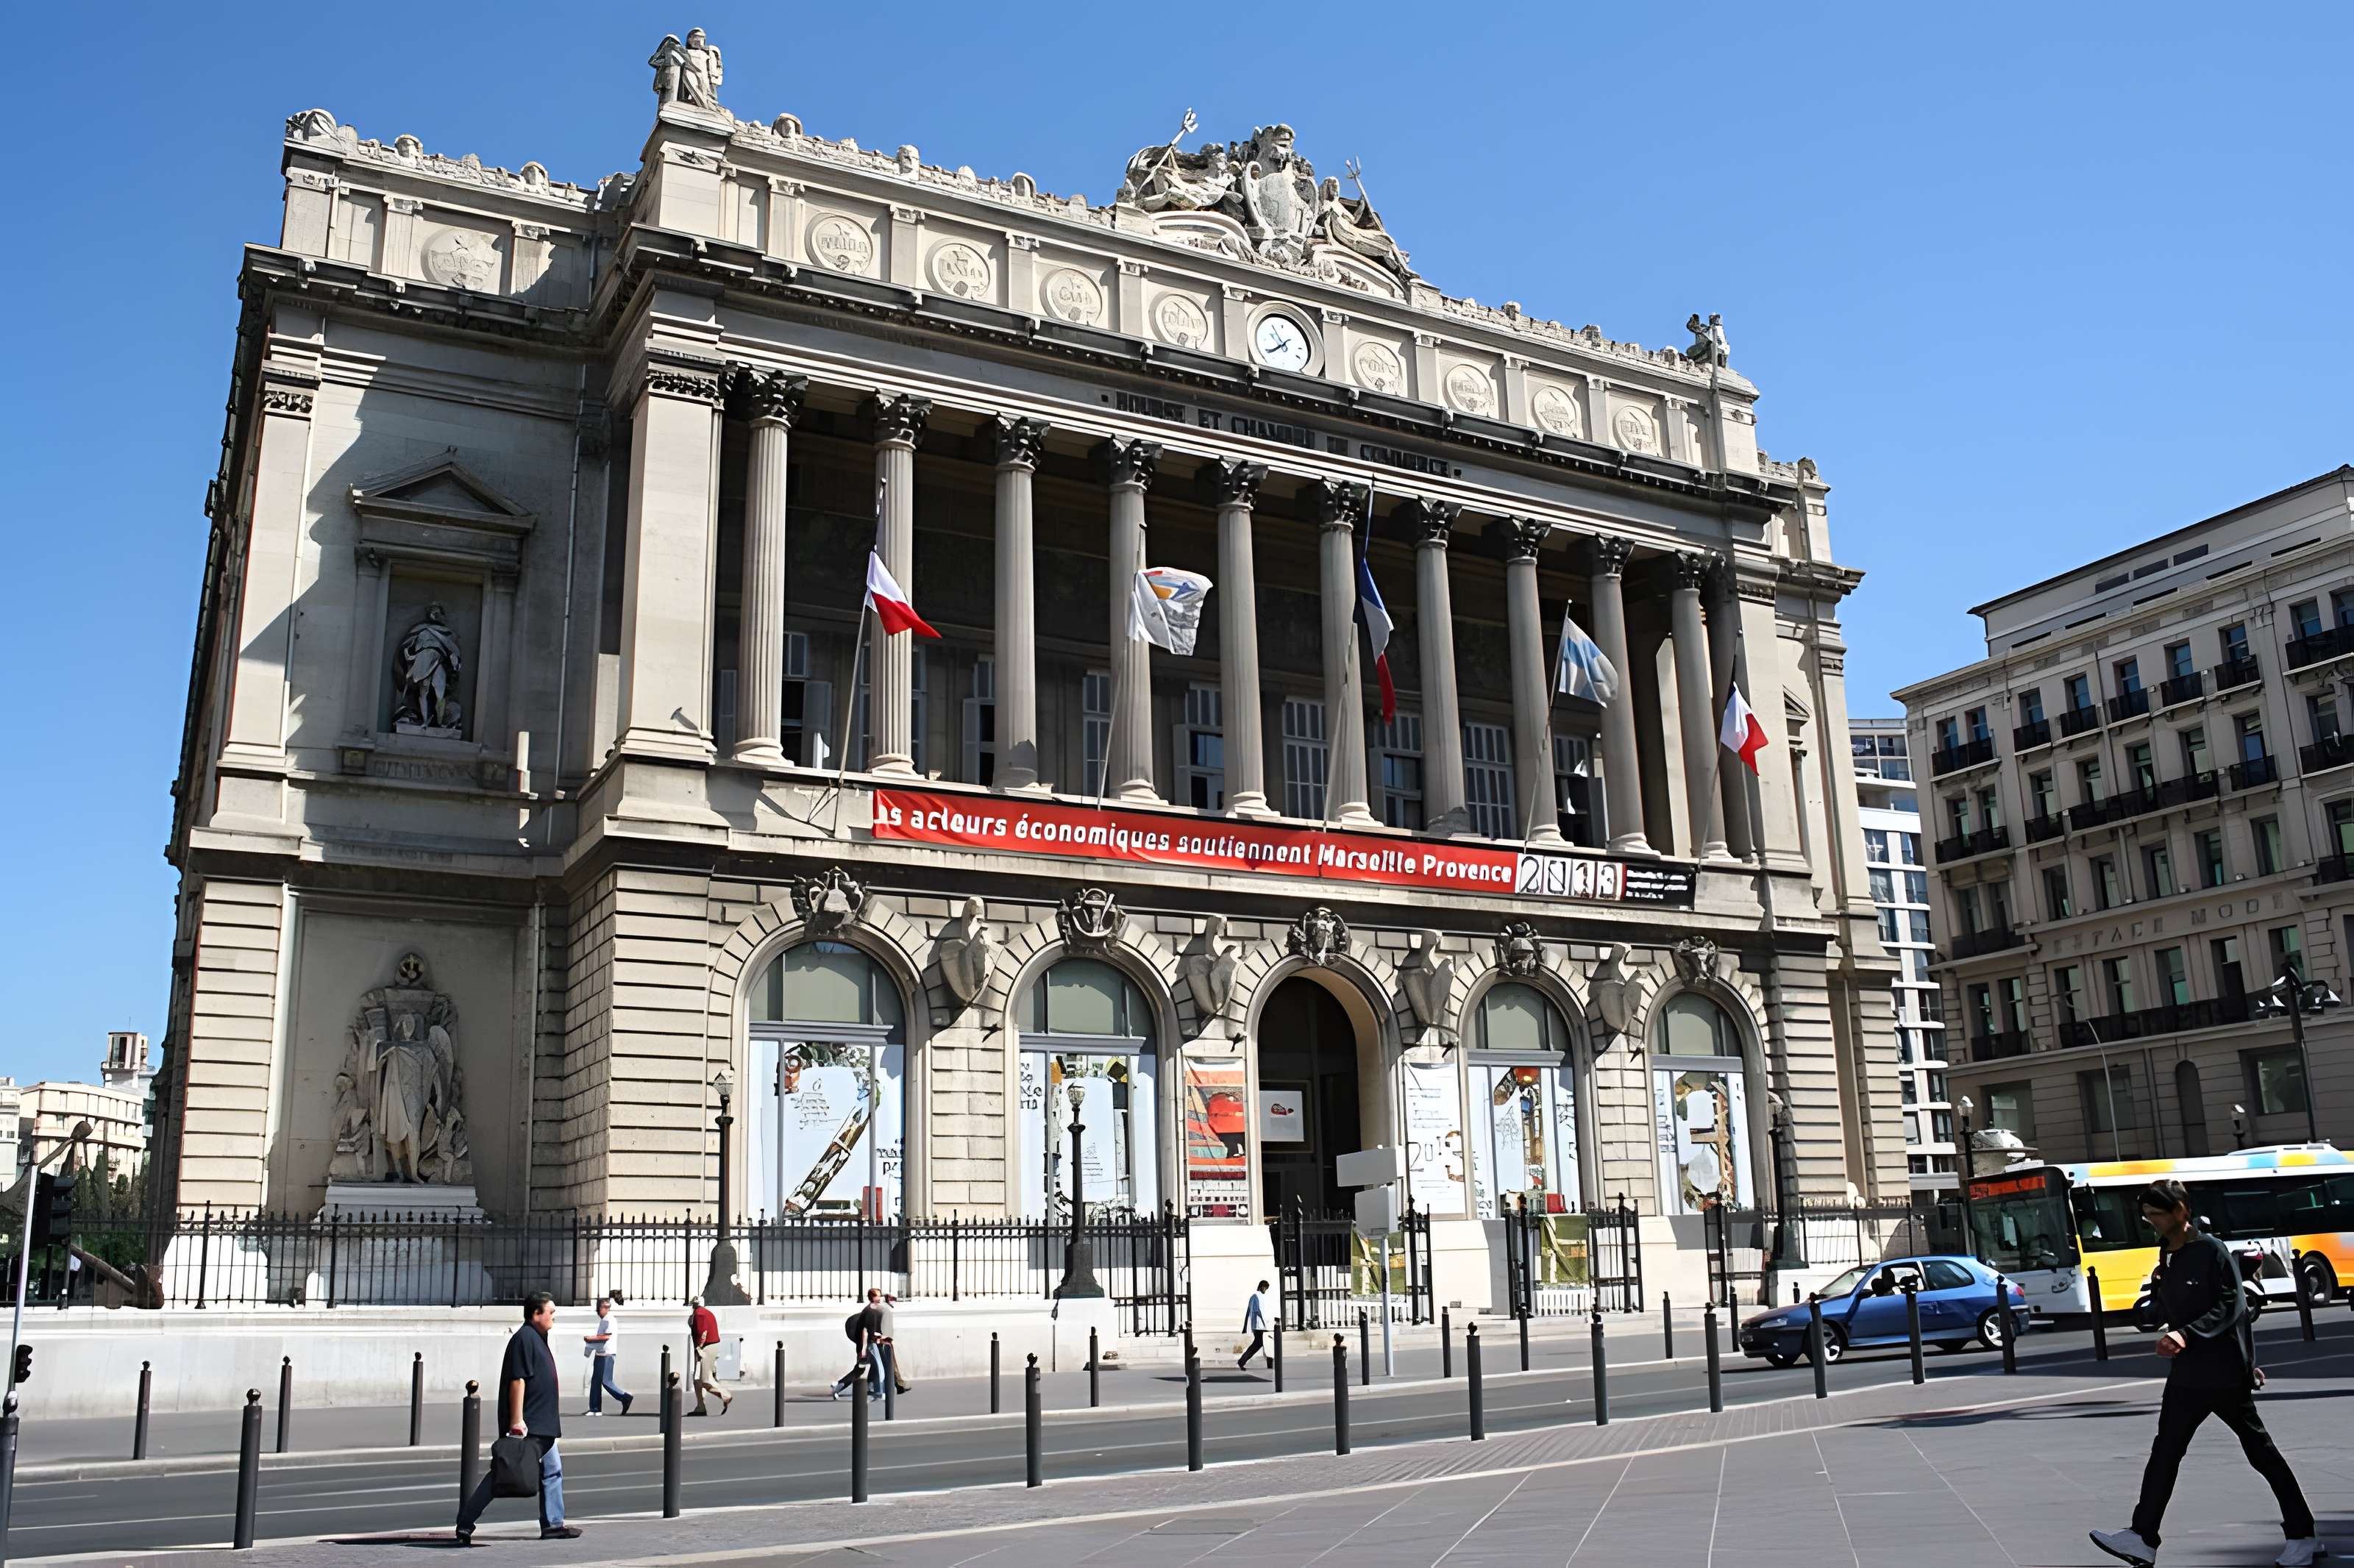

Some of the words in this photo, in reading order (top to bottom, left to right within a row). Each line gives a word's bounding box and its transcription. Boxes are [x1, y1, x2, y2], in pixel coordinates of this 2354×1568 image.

[911, 806, 1007, 837] acteurs
[1015, 813, 1170, 854] économiques
[1177, 835, 1311, 865] soutiennent
[1318, 844, 1417, 874] Marseille
[1423, 854, 1512, 883] Provence
